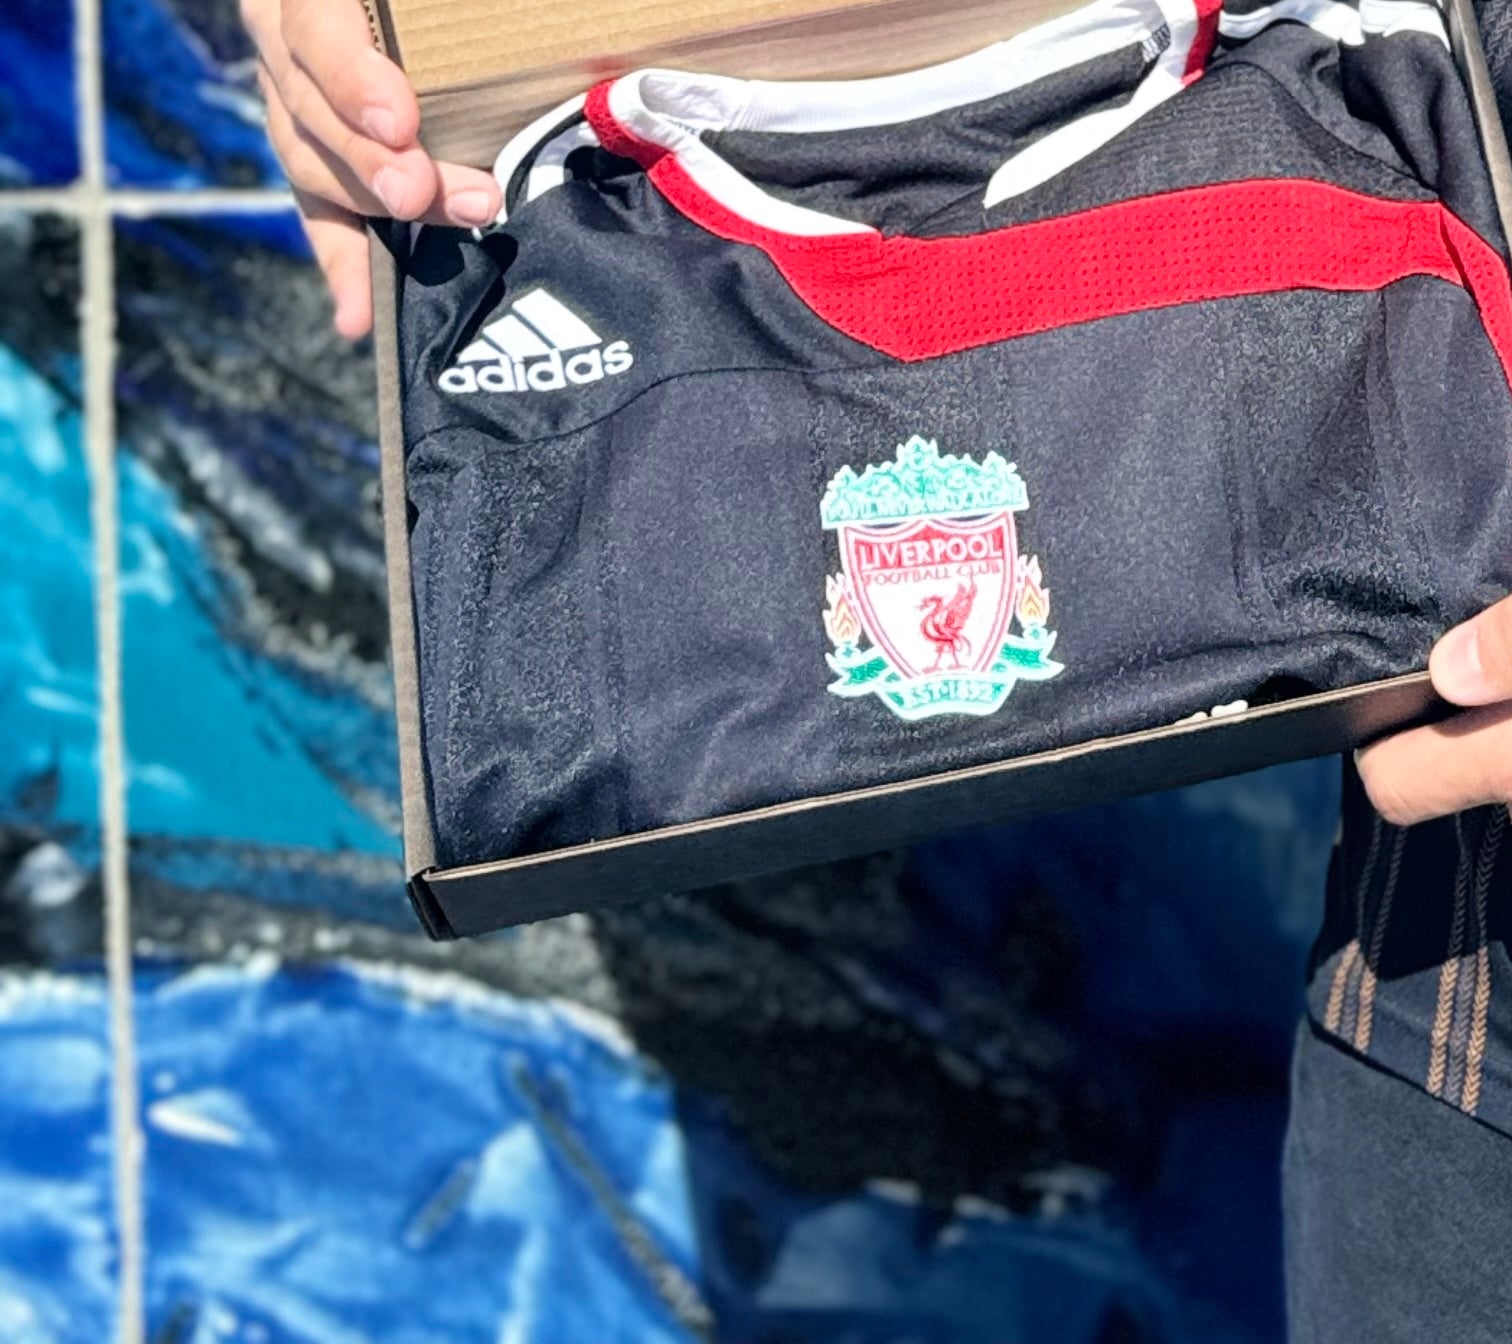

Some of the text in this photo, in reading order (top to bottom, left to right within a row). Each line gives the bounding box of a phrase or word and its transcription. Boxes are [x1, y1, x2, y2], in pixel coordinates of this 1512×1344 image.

[437, 340, 634, 394] adidas
[858, 533, 1004, 570] LIVERPOOL
[865, 561, 1001, 585] FOOTBALL CLUB
